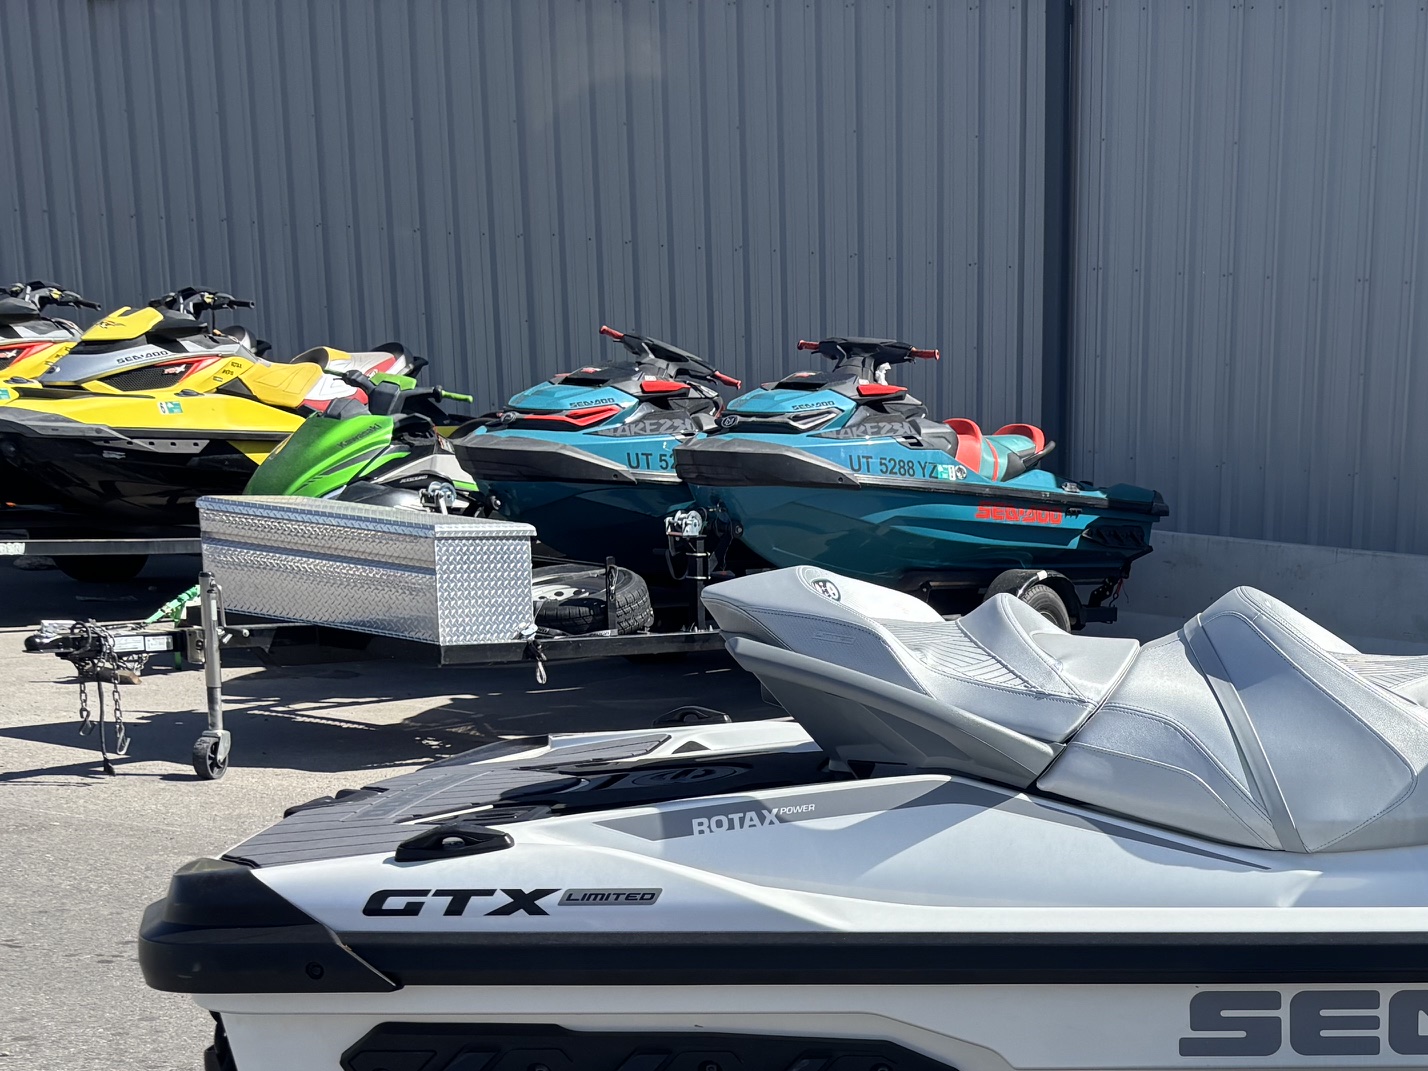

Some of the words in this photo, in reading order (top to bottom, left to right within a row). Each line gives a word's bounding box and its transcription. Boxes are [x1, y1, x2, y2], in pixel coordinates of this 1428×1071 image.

[336, 423, 383, 448] Kawasaki
[626, 452, 653, 470] UT
[848, 454, 873, 473] UT
[879, 457, 916, 478] 5288
[917, 461, 939, 479] YZ
[691, 808, 781, 836] ROTAX
[779, 803, 816, 815] POWER
[362, 888, 562, 917] GTX
[565, 892, 657, 902] LIMITED
